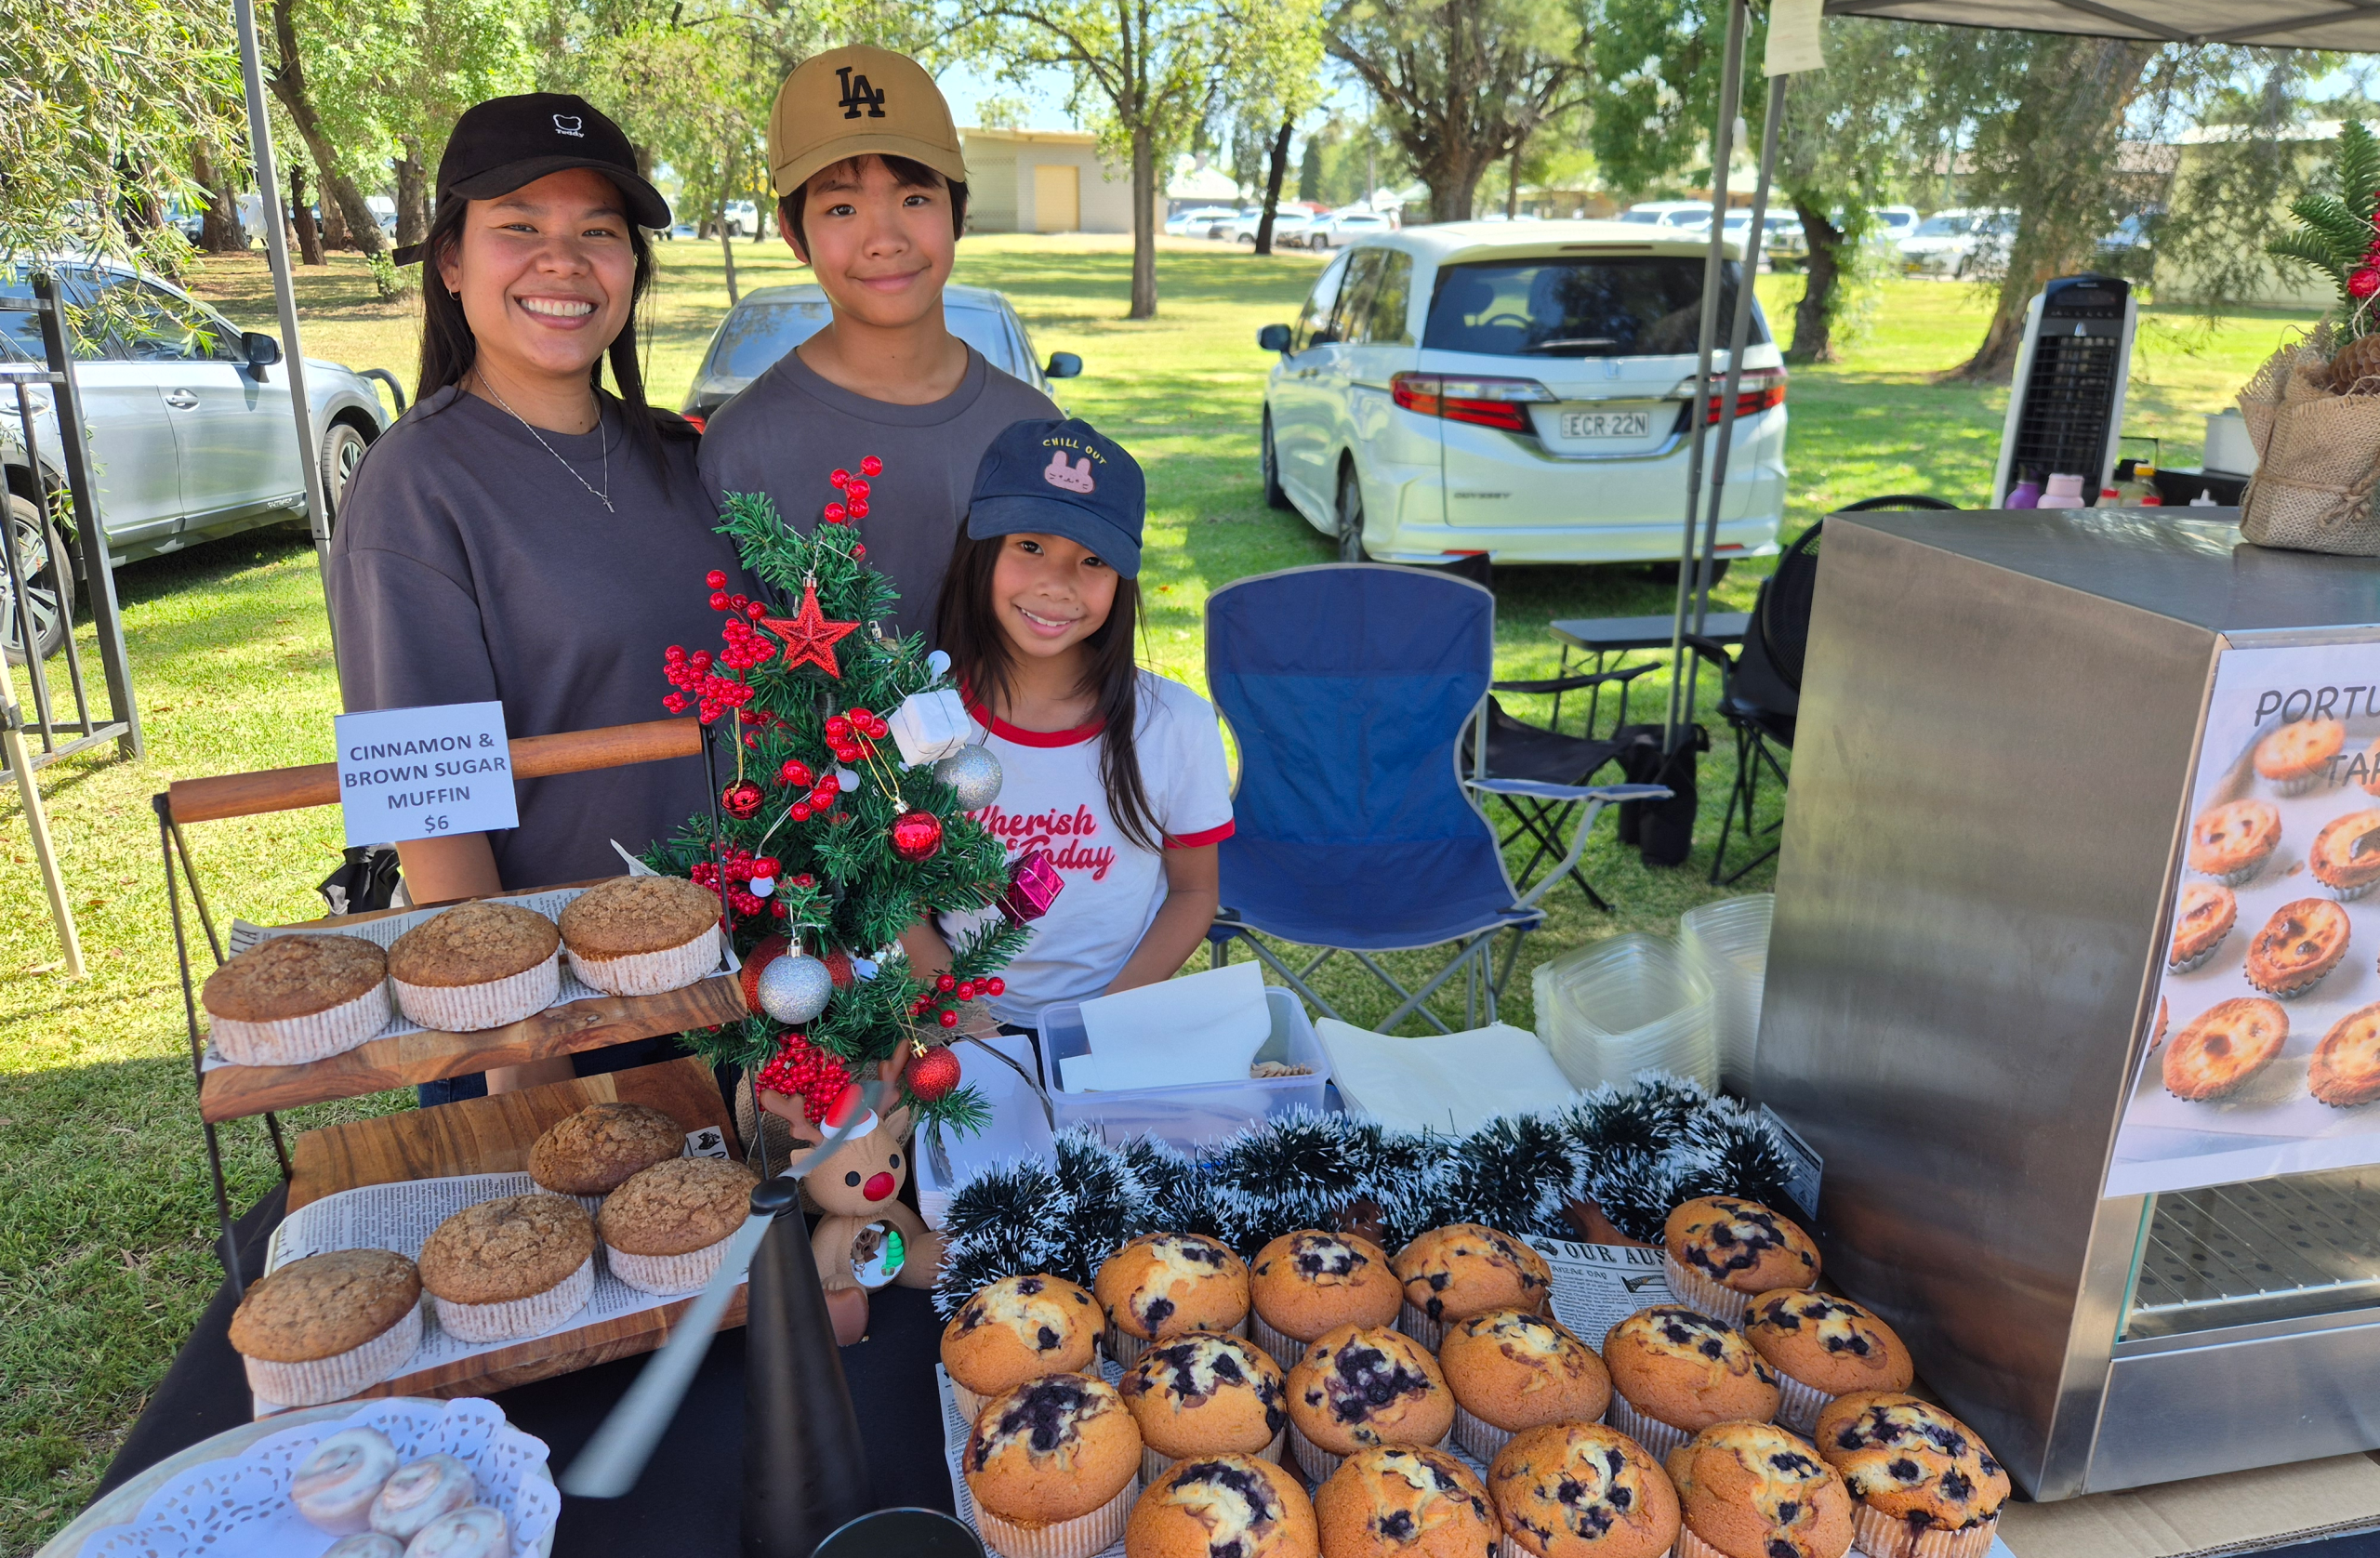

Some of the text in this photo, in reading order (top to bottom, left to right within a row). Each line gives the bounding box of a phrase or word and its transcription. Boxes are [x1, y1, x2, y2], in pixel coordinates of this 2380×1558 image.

[836, 66, 886, 119] LA
[555, 128, 585, 139] Teddy
[1042, 437, 1107, 464] CHILL OUT
[350, 733, 495, 761] CINNAMON &
[344, 757, 507, 788] BROWN SUGAR
[388, 786, 470, 810] MUFFIN
[424, 814, 450, 834] $6
[1564, 1242, 1617, 1263] OUR
